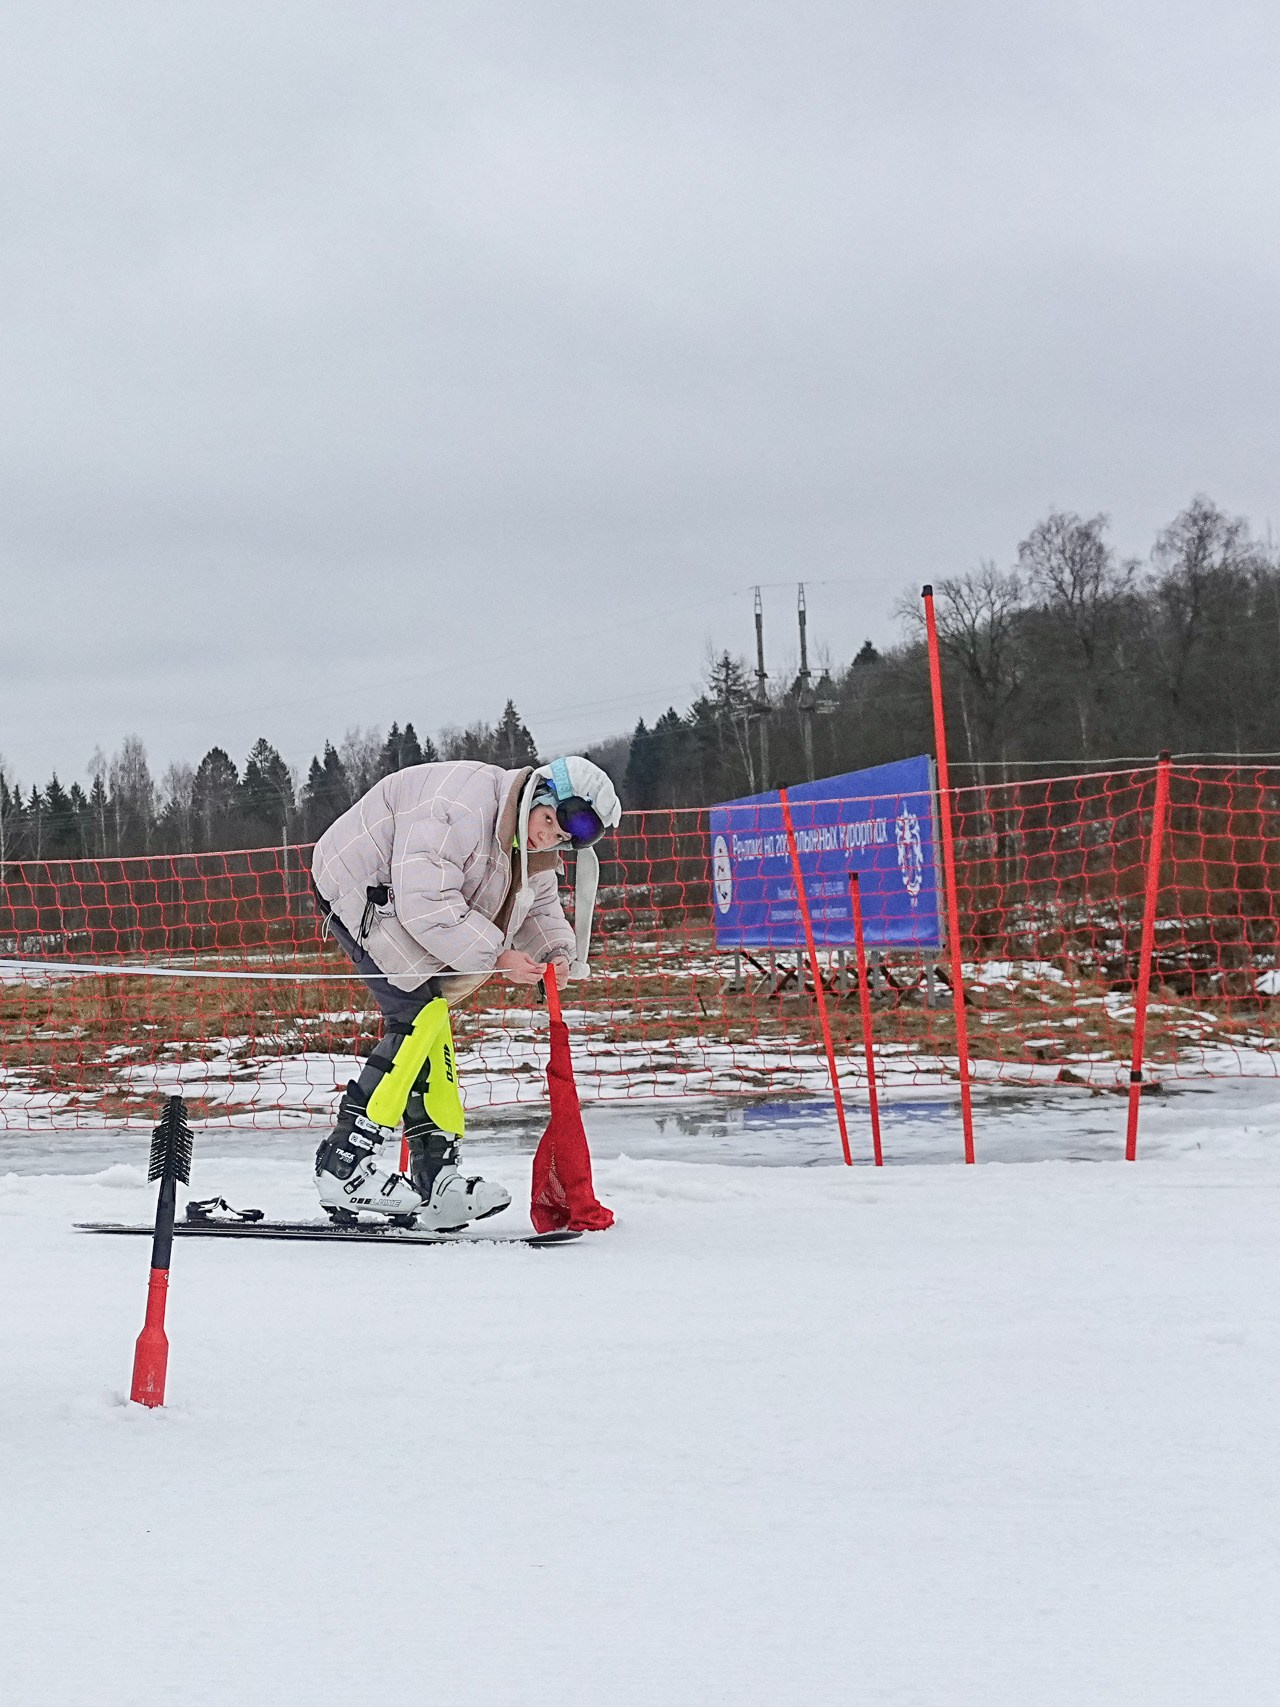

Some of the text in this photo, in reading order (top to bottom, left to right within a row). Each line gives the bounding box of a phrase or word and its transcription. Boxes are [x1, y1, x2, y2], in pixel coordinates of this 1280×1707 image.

[764, 836, 775, 858] на
[775, 826, 838, 863] горолыжных
[335, 1148, 356, 1158] TRACK
